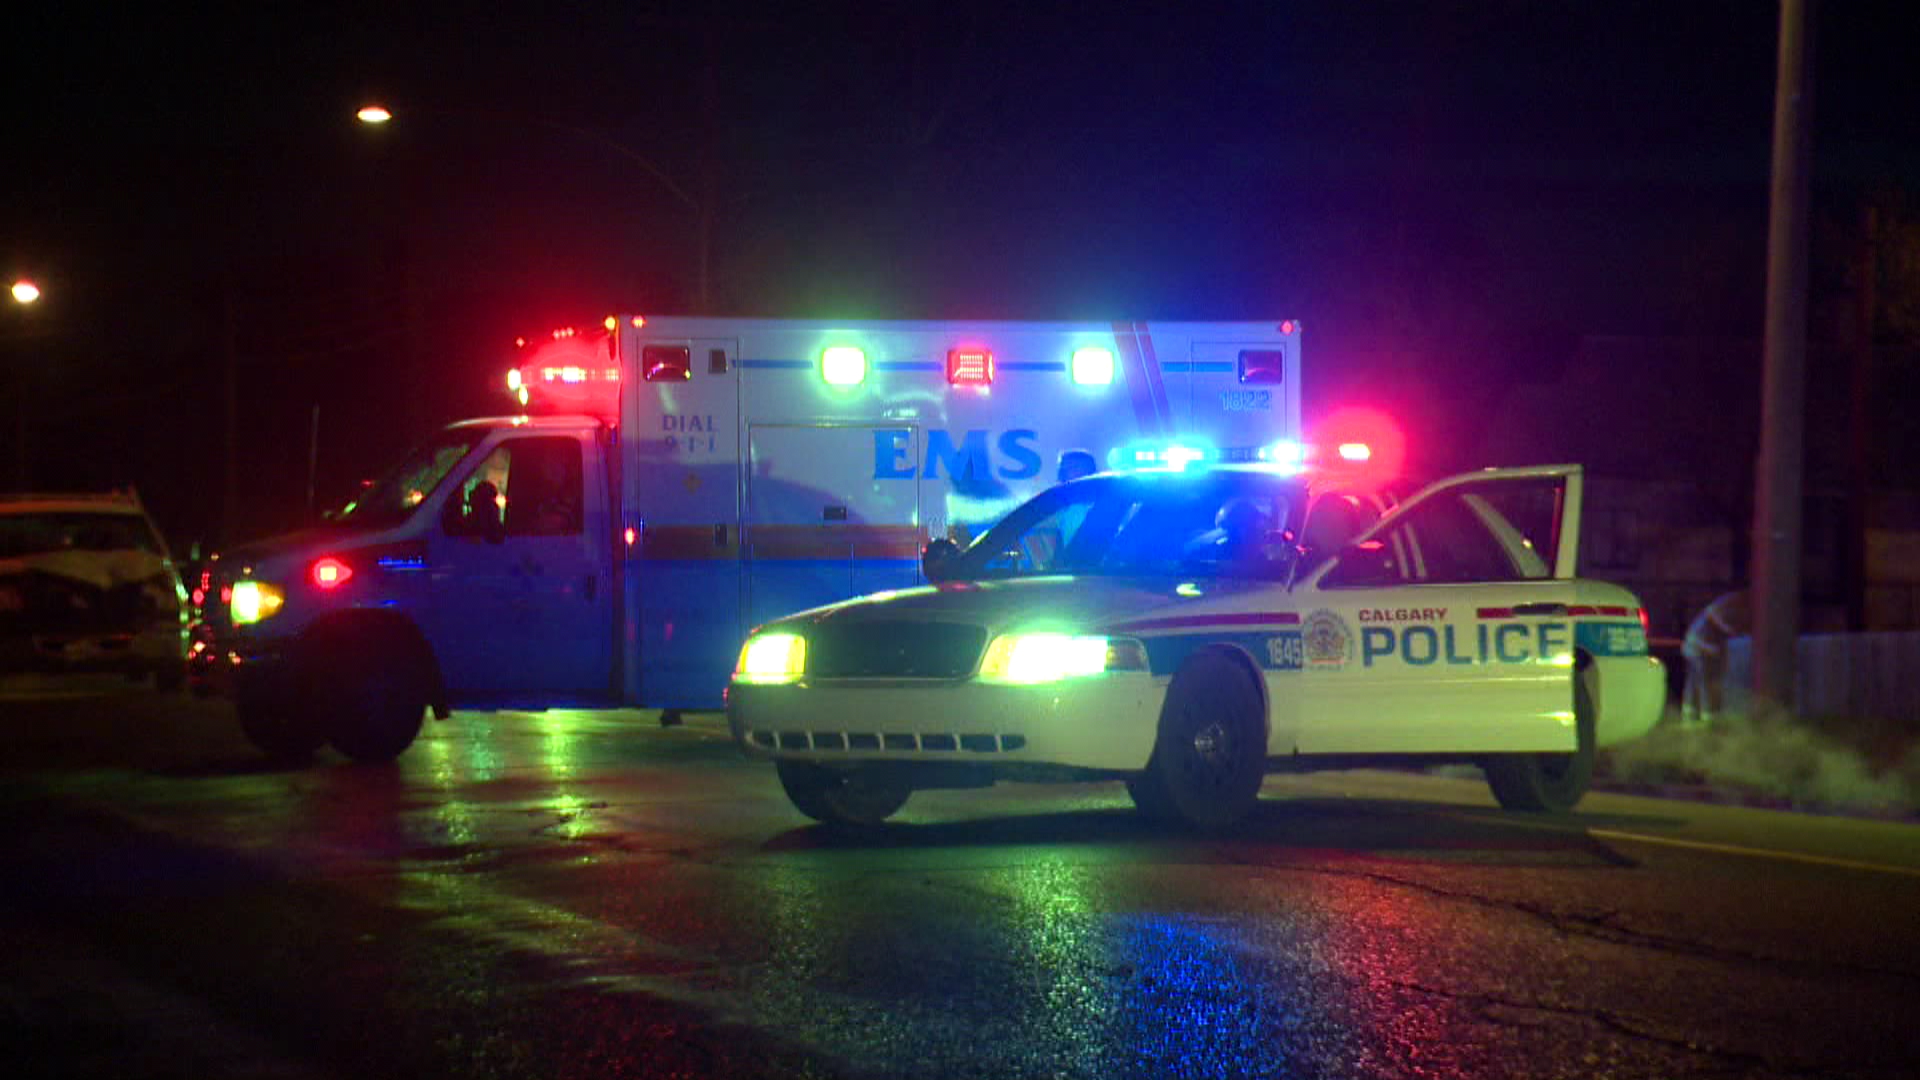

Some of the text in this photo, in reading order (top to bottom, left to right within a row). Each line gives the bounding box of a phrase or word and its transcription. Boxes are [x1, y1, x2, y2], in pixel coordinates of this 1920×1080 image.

[663, 415, 720, 432] DIAL
[873, 429, 1042, 480] EMS
[1359, 607, 1448, 622] CALGARY
[1361, 622, 1571, 667] POLICE
